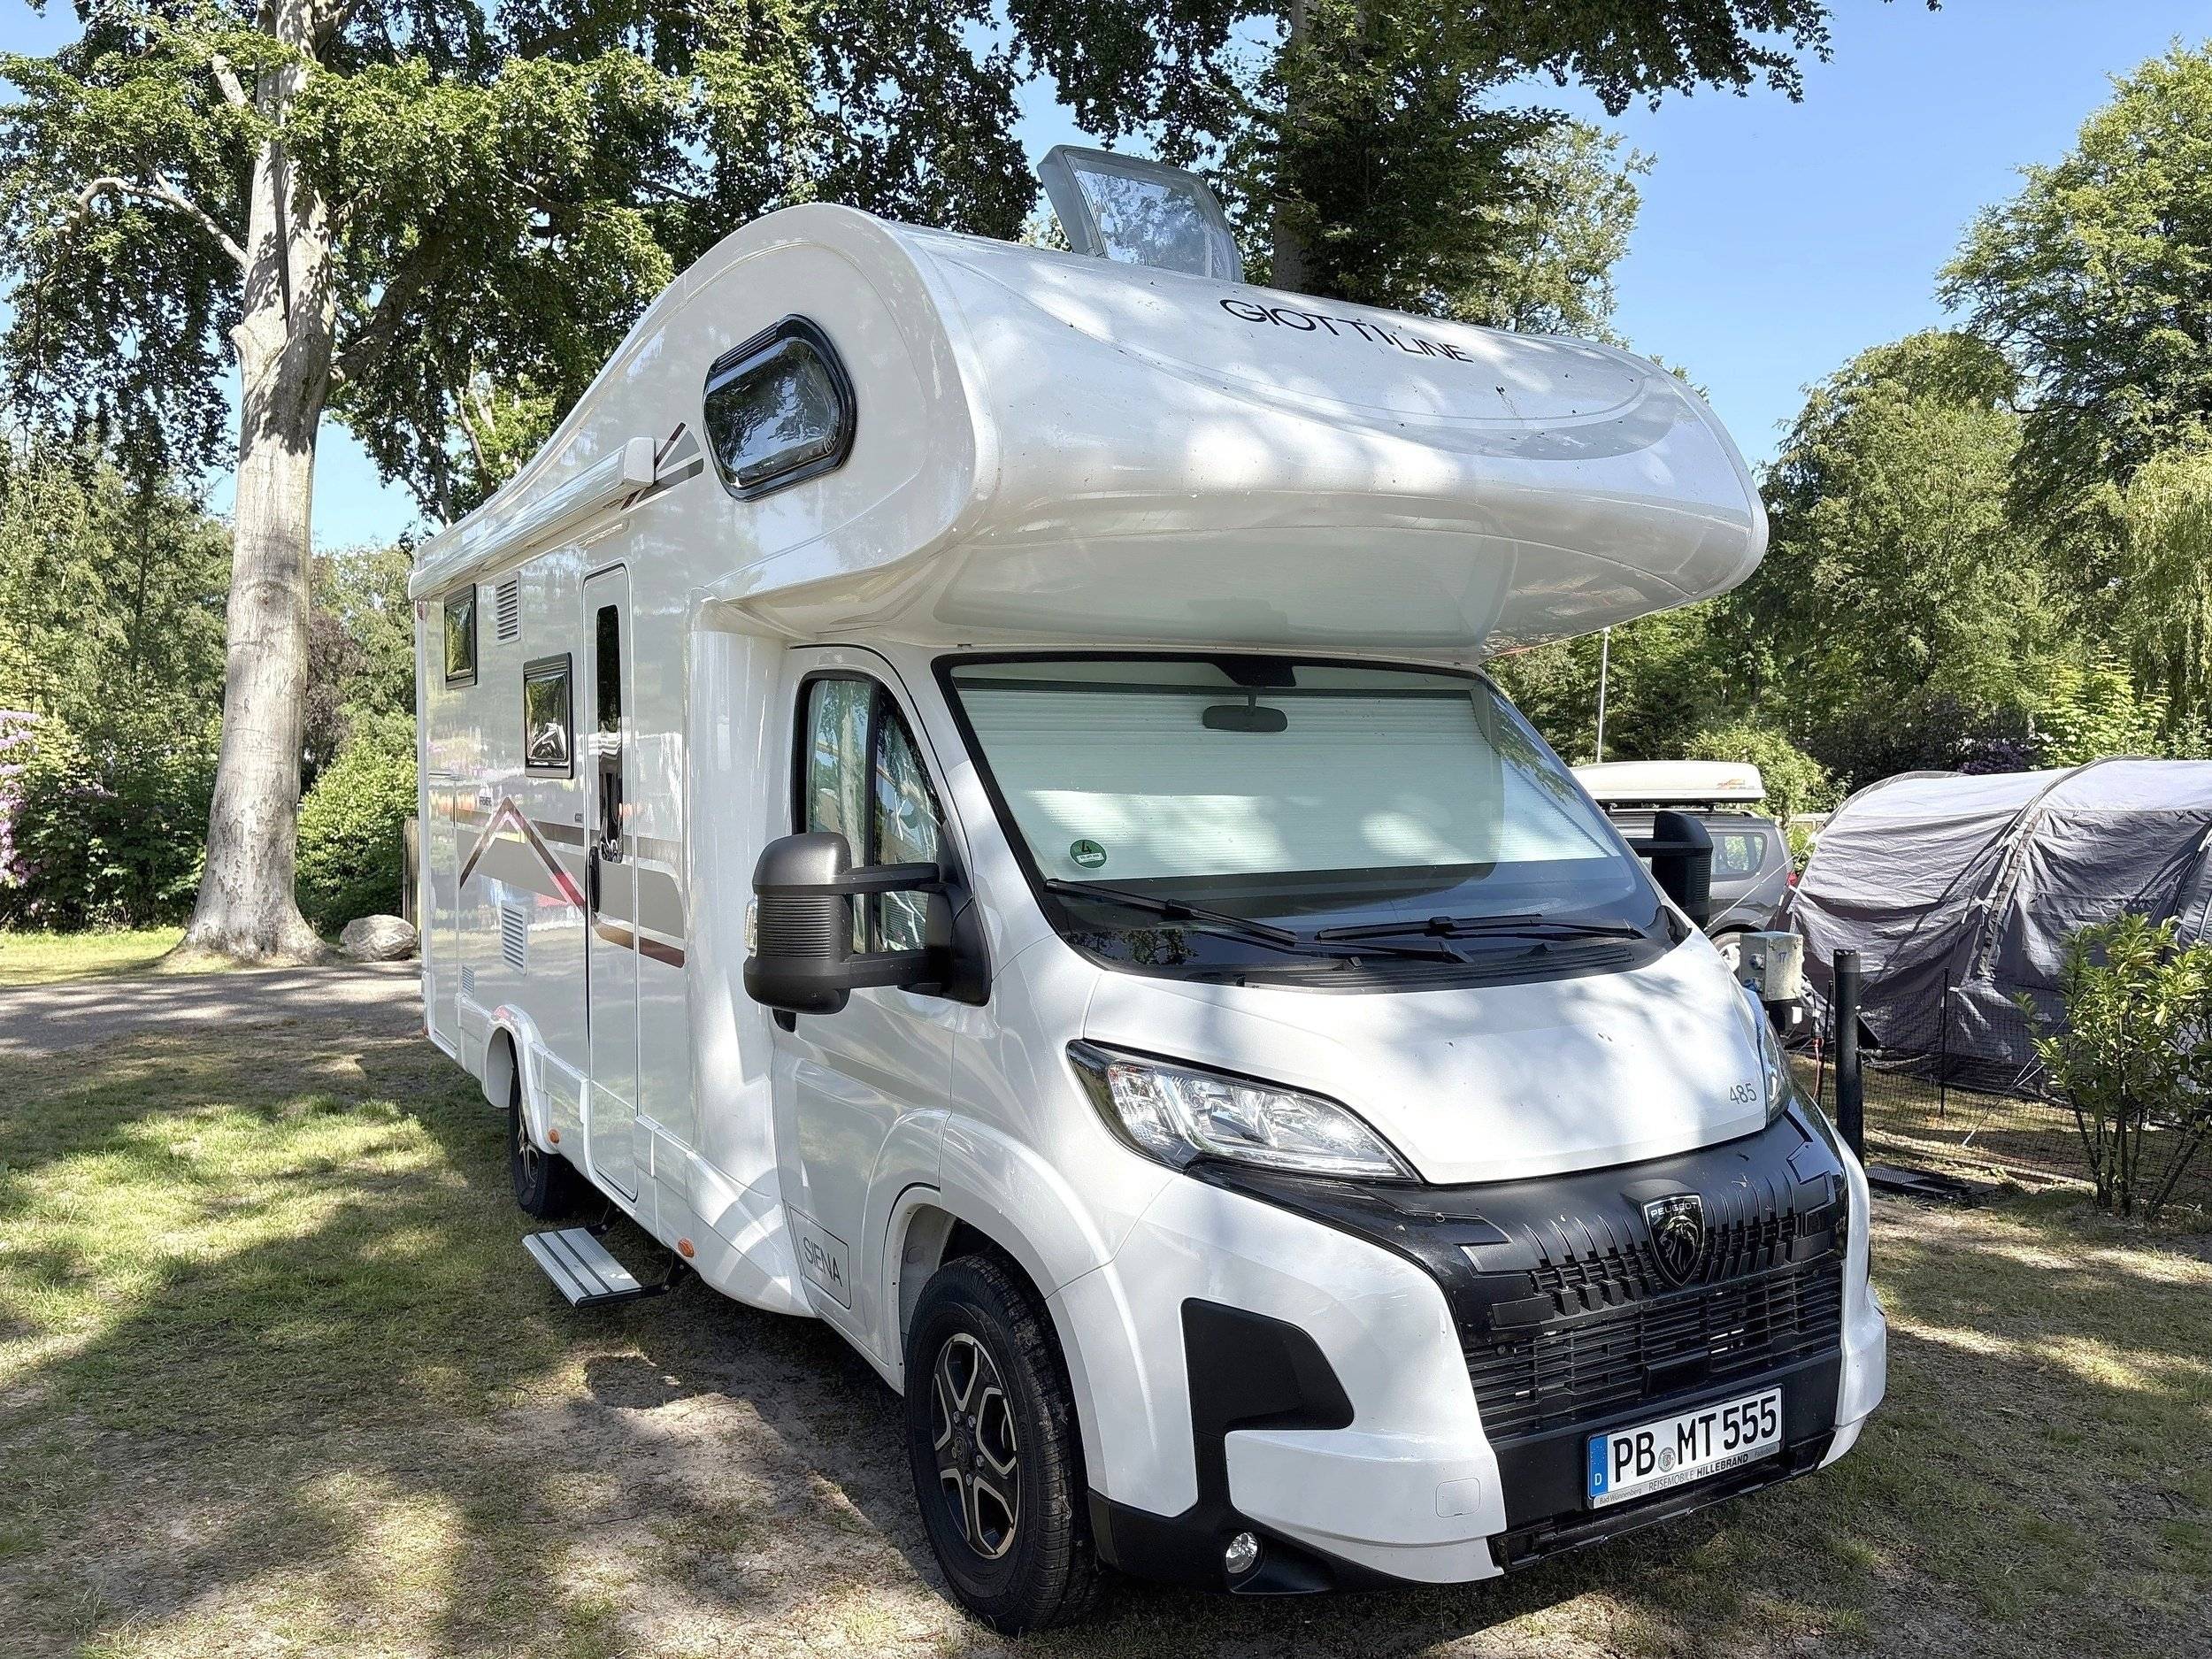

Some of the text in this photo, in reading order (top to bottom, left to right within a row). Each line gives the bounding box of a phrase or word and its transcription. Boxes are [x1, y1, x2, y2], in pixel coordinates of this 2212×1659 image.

[1729, 1082, 1757, 1105] 485
[1650, 1202, 1697, 1218] PEUGEOT
[803, 1236, 843, 1287] SIENA
[1613, 1395, 1777, 1483] PB MT 555
[1594, 1472, 1602, 1486] D
[1648, 1470, 1694, 1492] REISEMOBILE
[1696, 1453, 1748, 1478] HILLEBRAND
